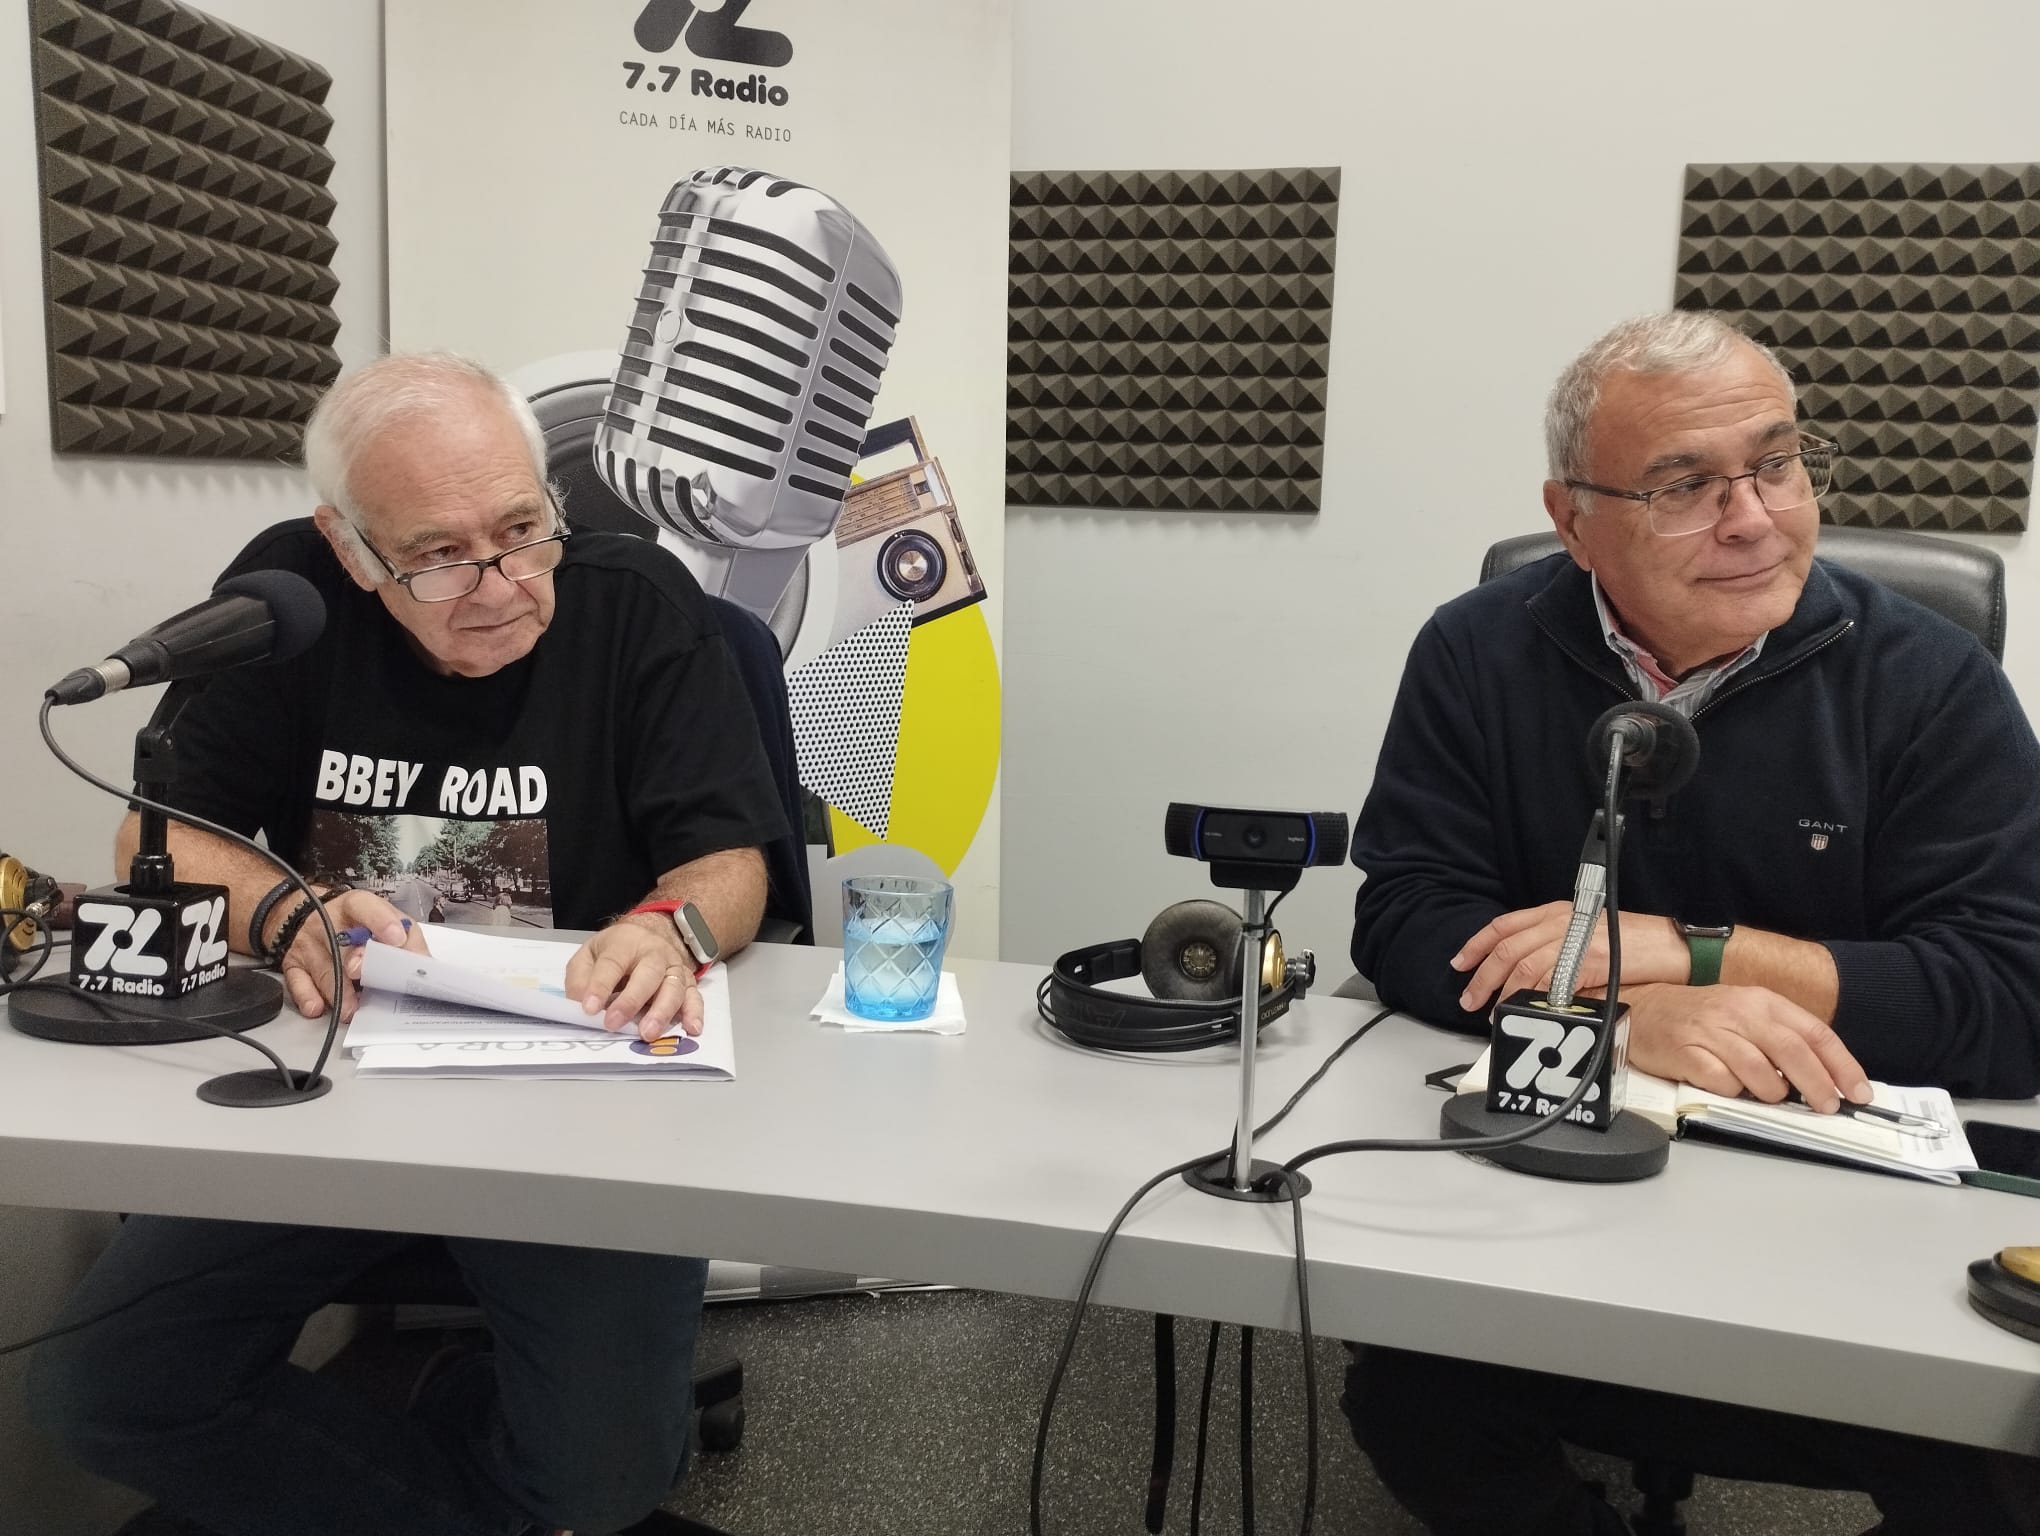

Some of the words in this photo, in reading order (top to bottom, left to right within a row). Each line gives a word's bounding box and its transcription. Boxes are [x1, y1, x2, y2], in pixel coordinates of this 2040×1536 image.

[622, 61, 681, 93] 7.7
[691, 68, 789, 107] Radio
[619, 111, 658, 128] CADA
[669, 113, 697, 131] DÍA
[707, 118, 735, 136] MÁS
[746, 125, 792, 142] RADIO
[315, 749, 424, 808] BBEY
[439, 765, 548, 816] ROAD
[1798, 818, 1848, 833] GANT
[78, 974, 108, 991] 7.7
[112, 977, 164, 996] Radio
[181, 973, 198, 993] 7.7
[198, 963, 226, 986] Radio
[1498, 1091, 1532, 1111] 7.7
